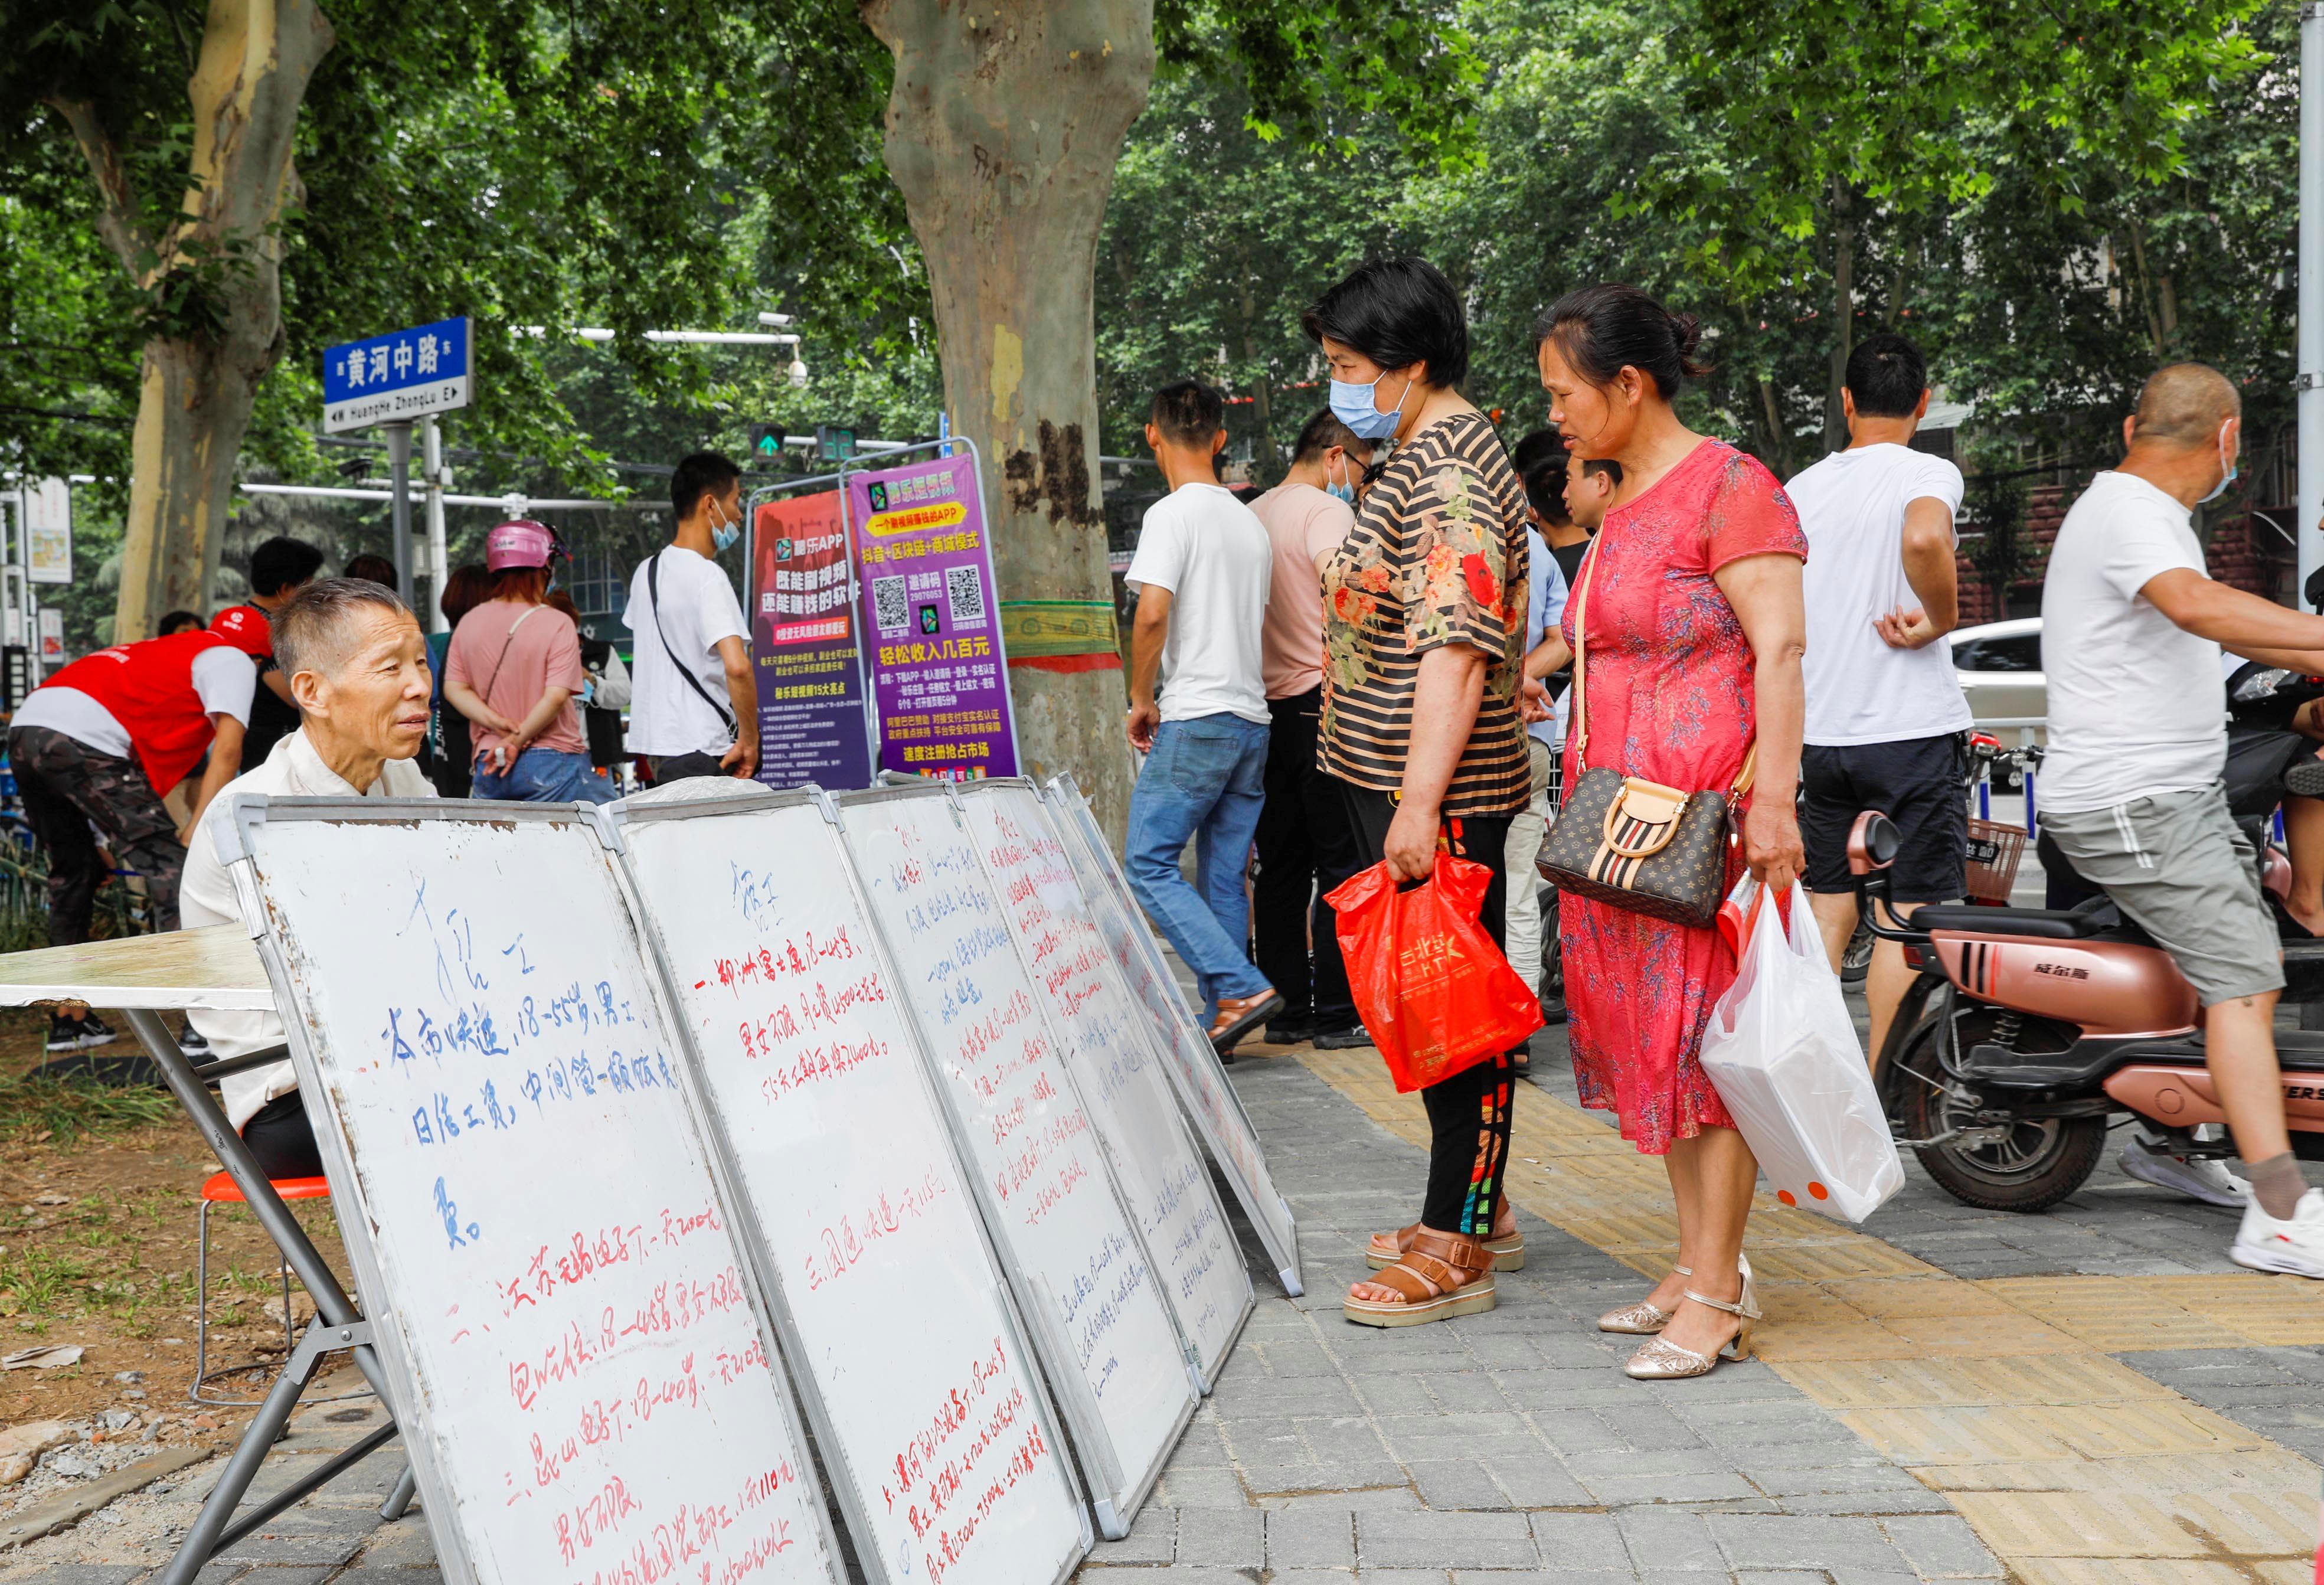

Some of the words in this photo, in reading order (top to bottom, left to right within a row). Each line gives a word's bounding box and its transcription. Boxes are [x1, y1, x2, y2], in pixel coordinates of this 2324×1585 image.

[347, 334, 439, 389] 黄河中路
[442, 340, 451, 355] 东
[351, 400, 391, 421] HuangHe
[395, 391, 436, 414] ZhongLu
[444, 387, 450, 401] E
[875, 508, 956, 530] 一个刷视频赚钱的APP
[862, 531, 980, 565] 抖音+区块链+商城模式
[776, 560, 847, 591] 既能刷视频
[908, 571, 942, 590] 邀请码
[762, 580, 861, 615] 还能赚钱的软件
[879, 636, 991, 666] 轻松收入几百元
[933, 709, 1000, 724] 对接支付宝实名认证
[888, 727, 931, 740] 政府重点扶持
[903, 741, 989, 762] 速度注册抢占市场
[2282, 1086, 2324, 1100] ERS
